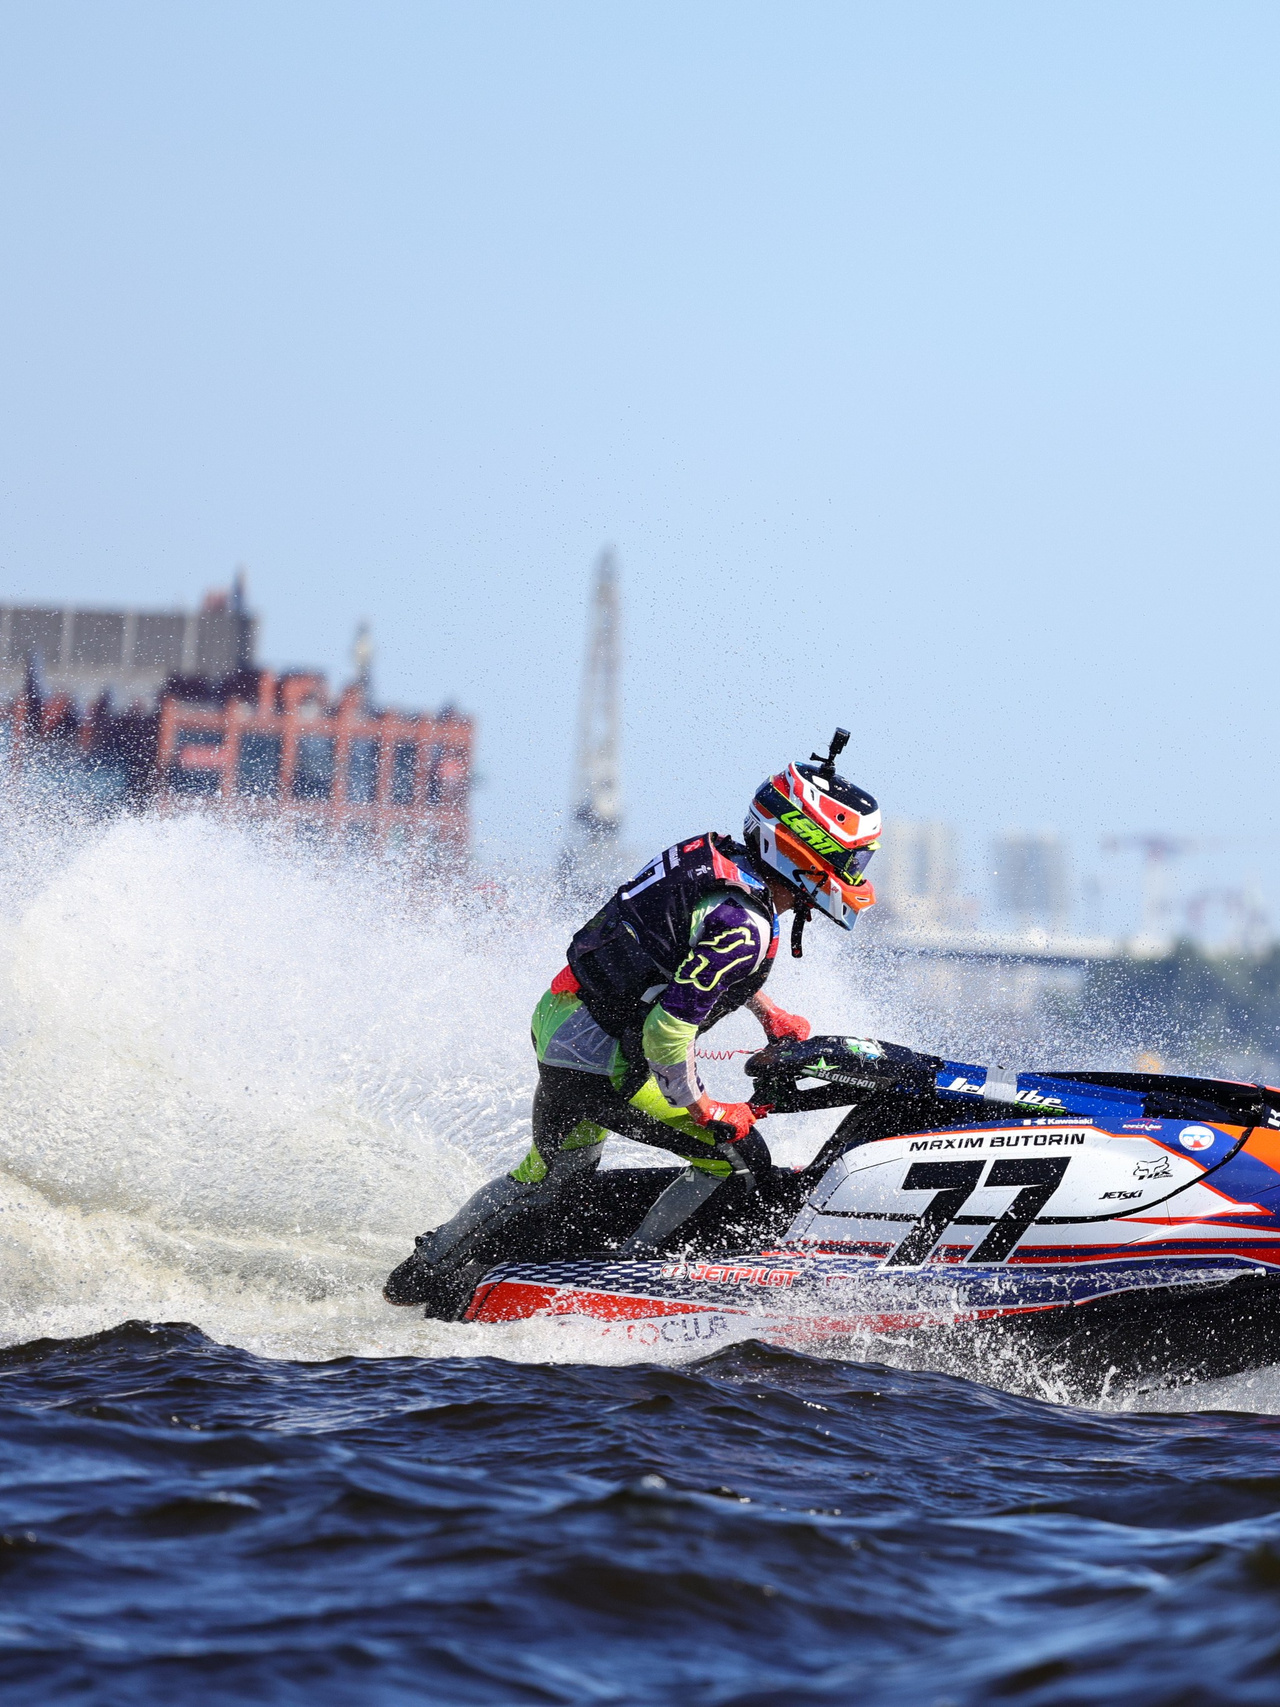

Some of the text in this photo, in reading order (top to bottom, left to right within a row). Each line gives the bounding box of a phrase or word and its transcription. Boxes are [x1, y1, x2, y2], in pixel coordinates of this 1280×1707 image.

[780, 810, 846, 855] LEATT
[1047, 1118, 1094, 1126] Kawasaki
[909, 1133, 1086, 1152] MAXIM BUTORIN
[880, 1156, 1072, 1267] 77
[689, 1263, 803, 1288] JETPILOT
